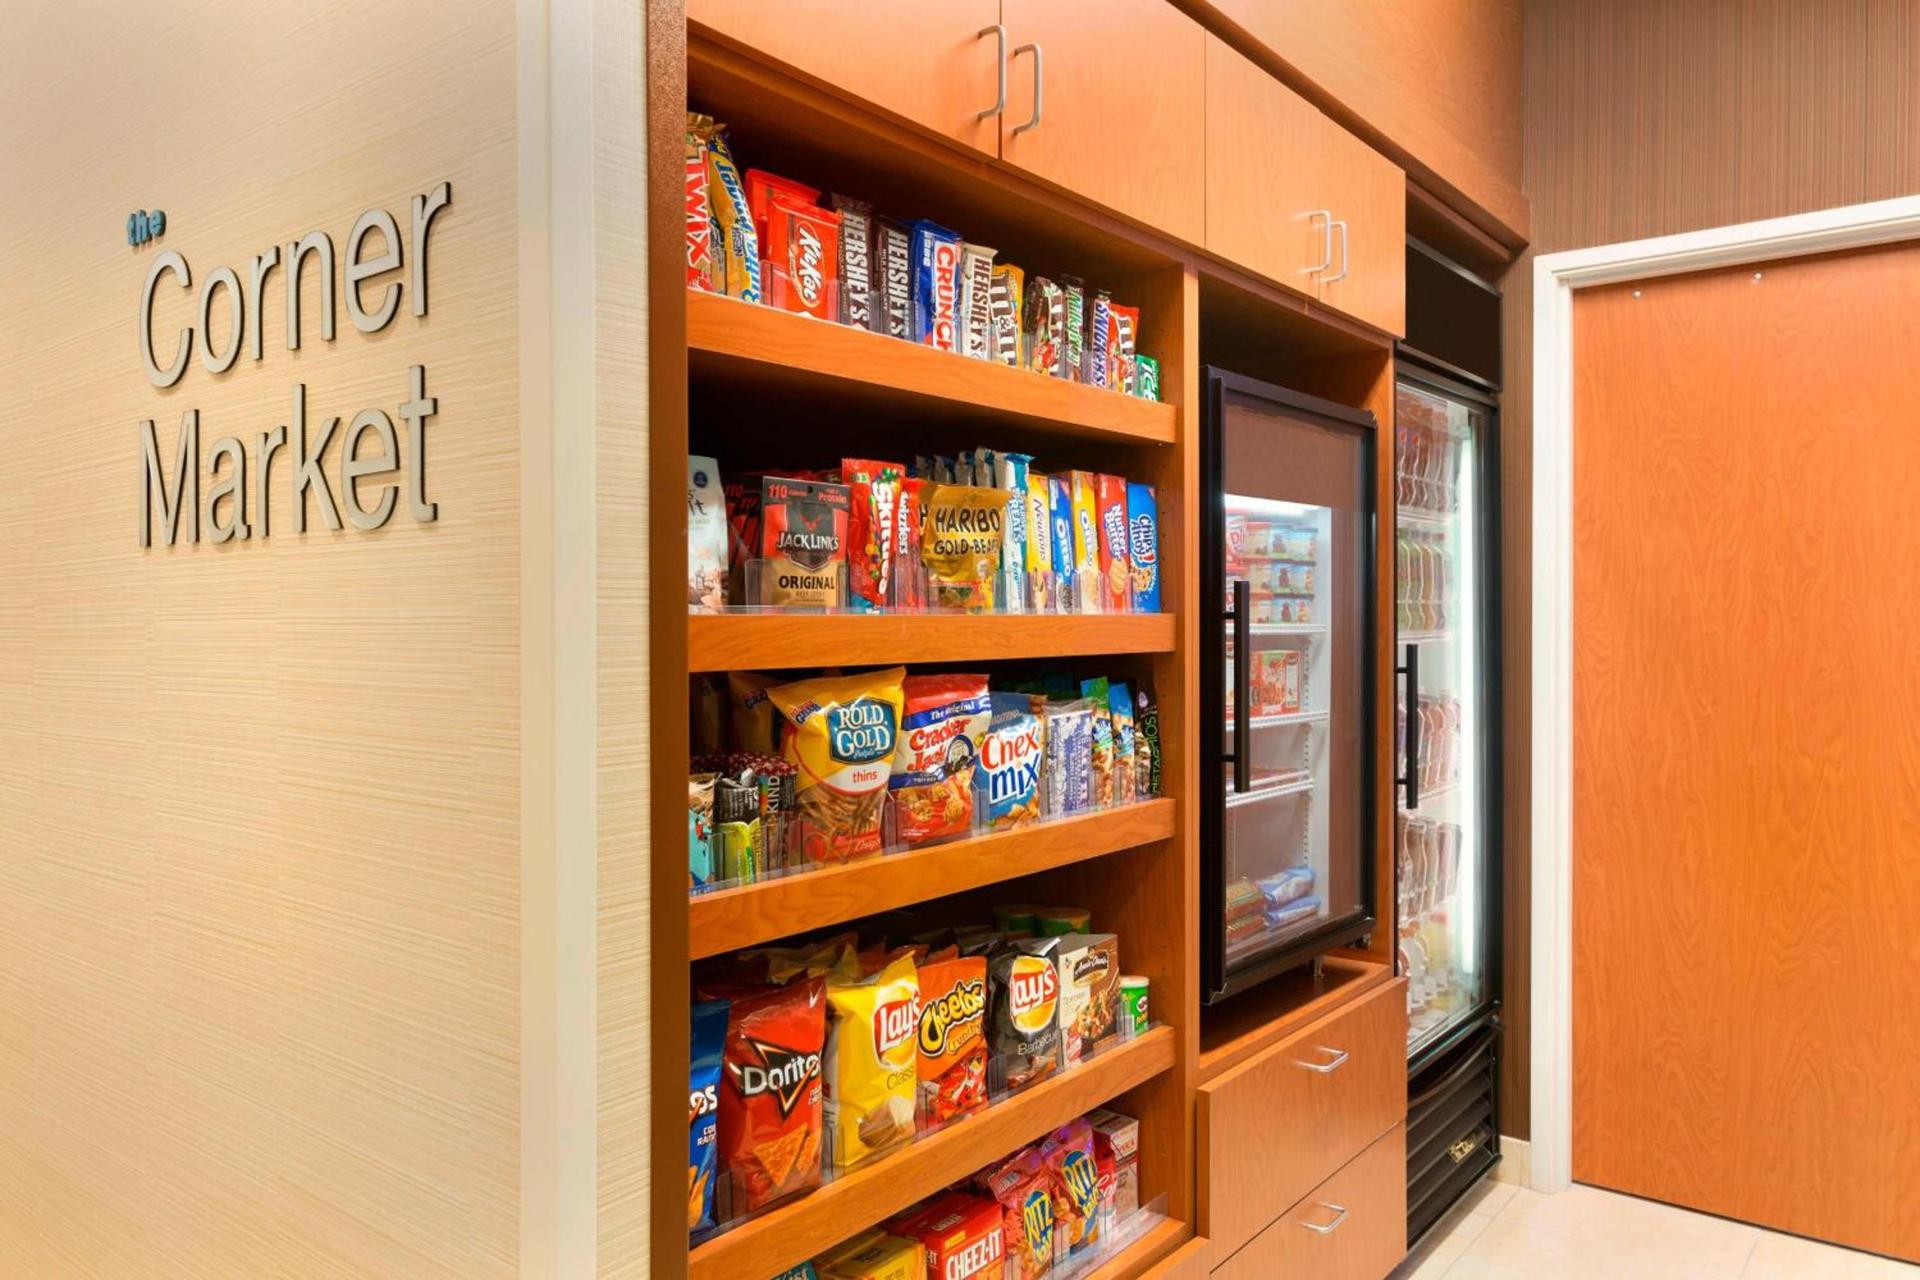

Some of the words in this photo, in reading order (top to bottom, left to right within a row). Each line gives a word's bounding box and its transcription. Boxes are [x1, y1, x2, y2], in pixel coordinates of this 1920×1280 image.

[127, 209, 167, 246] the
[685, 148, 711, 266] TWIX
[139, 182, 452, 388] Corner
[844, 212, 870, 325] HERSHEY'S
[888, 230, 909, 338] HERSHEY'S
[970, 257, 991, 352] HERSHEY'S
[1094, 301, 1108, 386] SNICKERS
[139, 365, 439, 547] Market
[769, 484, 788, 498] 110
[776, 532, 810, 549] JACK
[935, 508, 1001, 533] HARIBO
[1033, 499, 1047, 561] Newtons
[1056, 518, 1071, 577] OREO
[778, 575, 834, 590] ORIGINAL
[836, 727, 890, 757] GOLD
[909, 719, 971, 751] Cracker
[981, 727, 1039, 770] Chex
[768, 776, 780, 814] KIND
[852, 768, 878, 784] thins
[879, 996, 919, 1052] Lay's
[919, 981, 985, 1055] Cheetos
[1062, 1154, 1098, 1207] RITZ
[1024, 1193, 1053, 1243] RITZ
[947, 1228, 1001, 1280] CHEEZ-IT
